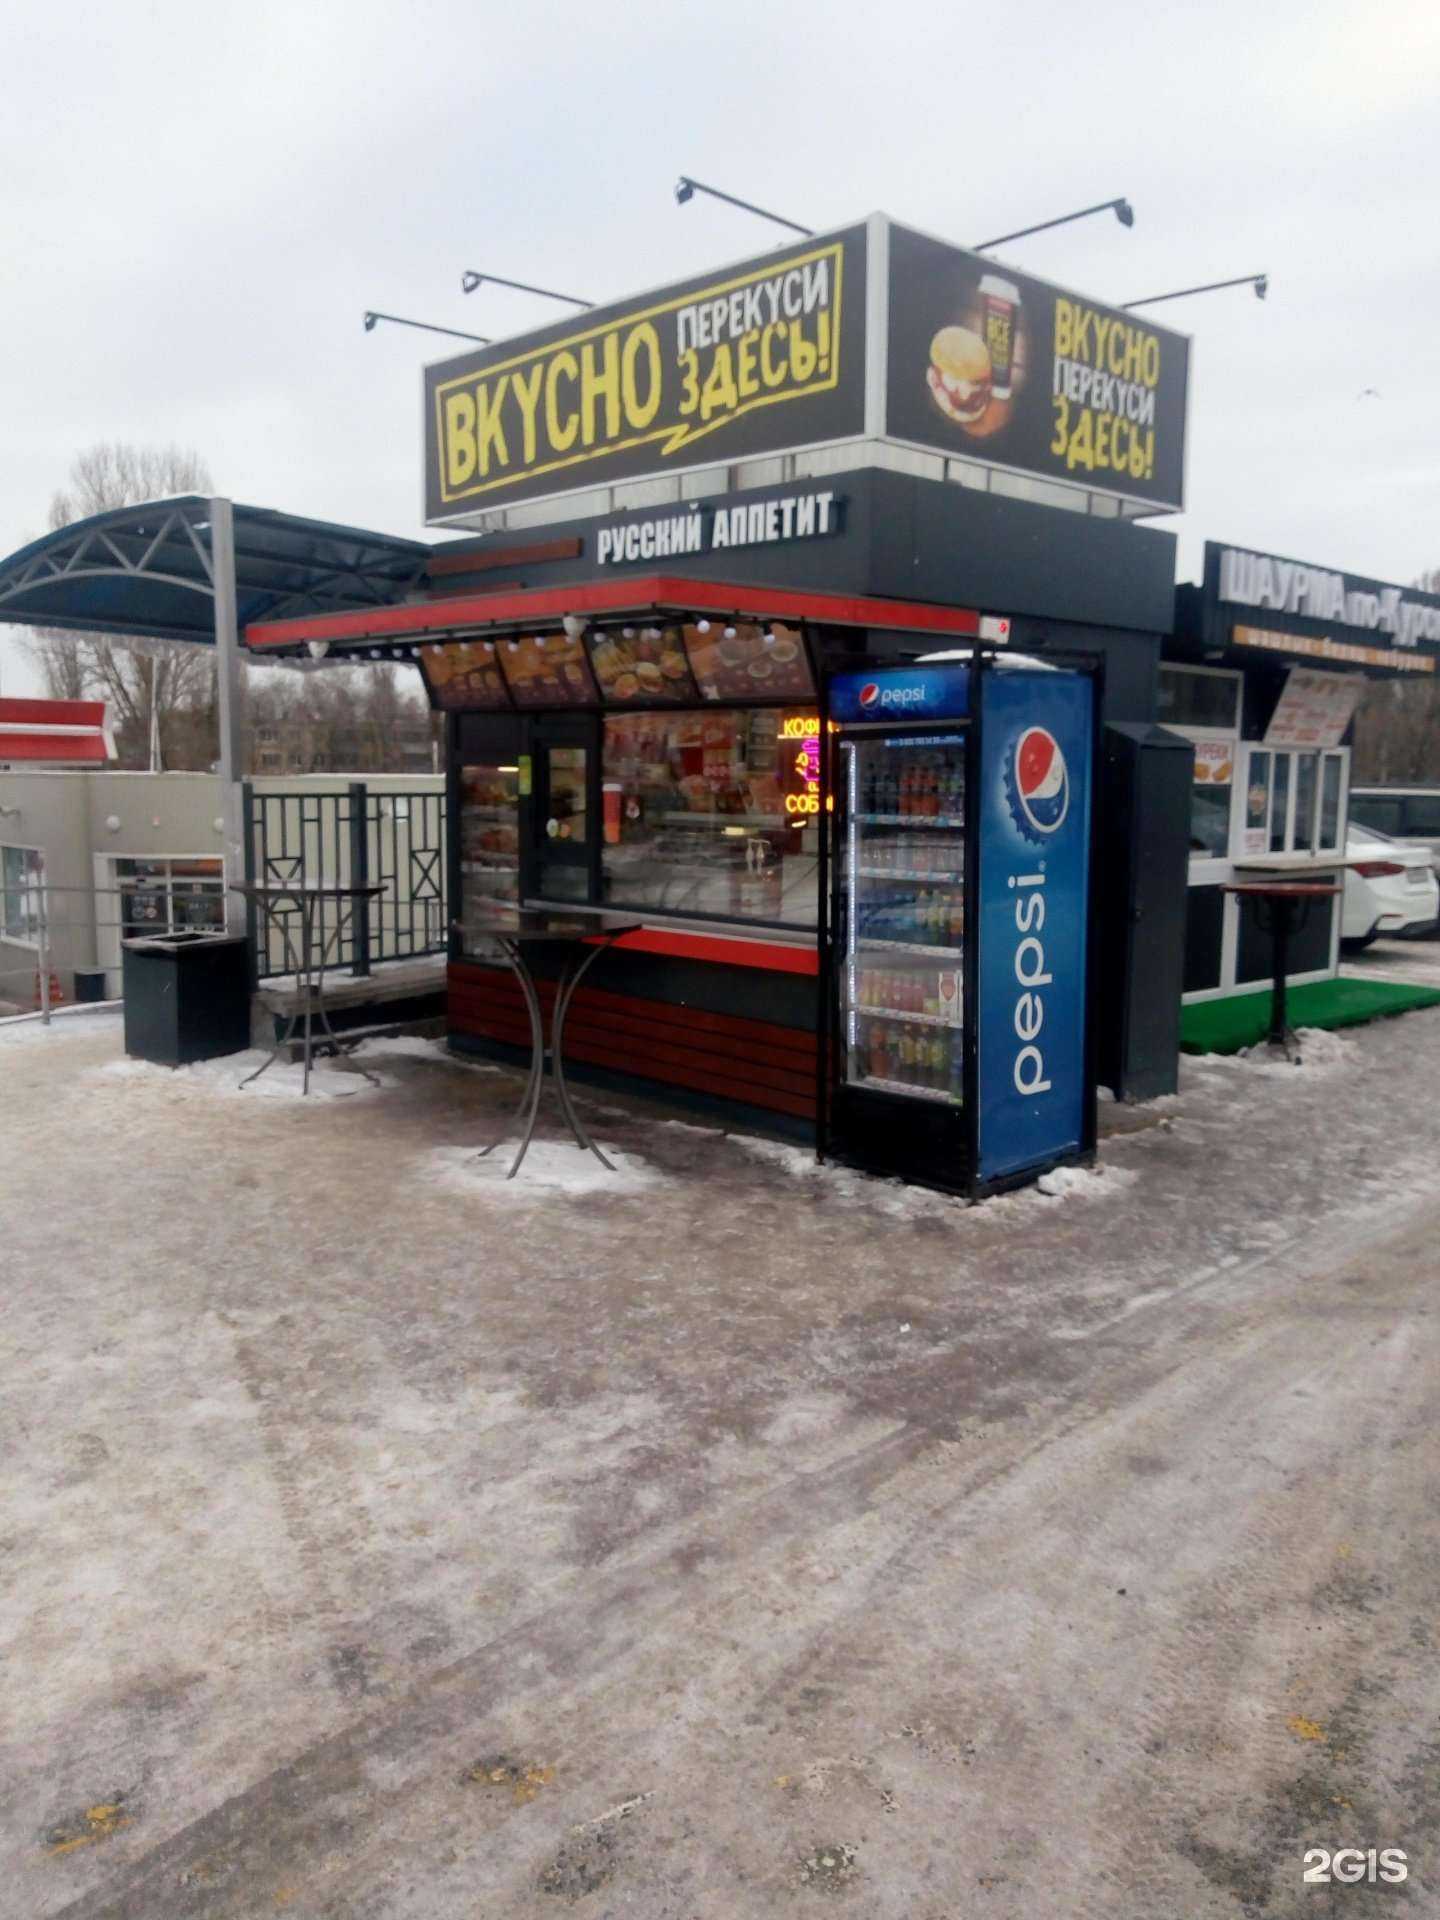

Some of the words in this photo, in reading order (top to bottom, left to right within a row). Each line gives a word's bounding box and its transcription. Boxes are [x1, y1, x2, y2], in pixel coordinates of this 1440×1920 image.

[676, 259, 829, 356] ПЕРЕКУСИ
[1055, 298, 1160, 388] ВКУСНО
[445, 320, 662, 487] ВКУСНО
[677, 310, 830, 420] ЗДЕСЬ!
[1053, 357, 1155, 426] ПЕРЕКУСИ
[1050, 397, 1154, 480] ЗДЕСЬ!
[597, 502, 702, 565] РУССКИЙ
[711, 491, 835, 549] АППЕТИТ
[1218, 549, 1346, 624] ШАУРМА
[881, 684, 926, 706] pepsi
[1008, 873, 1053, 1096] pepsi
